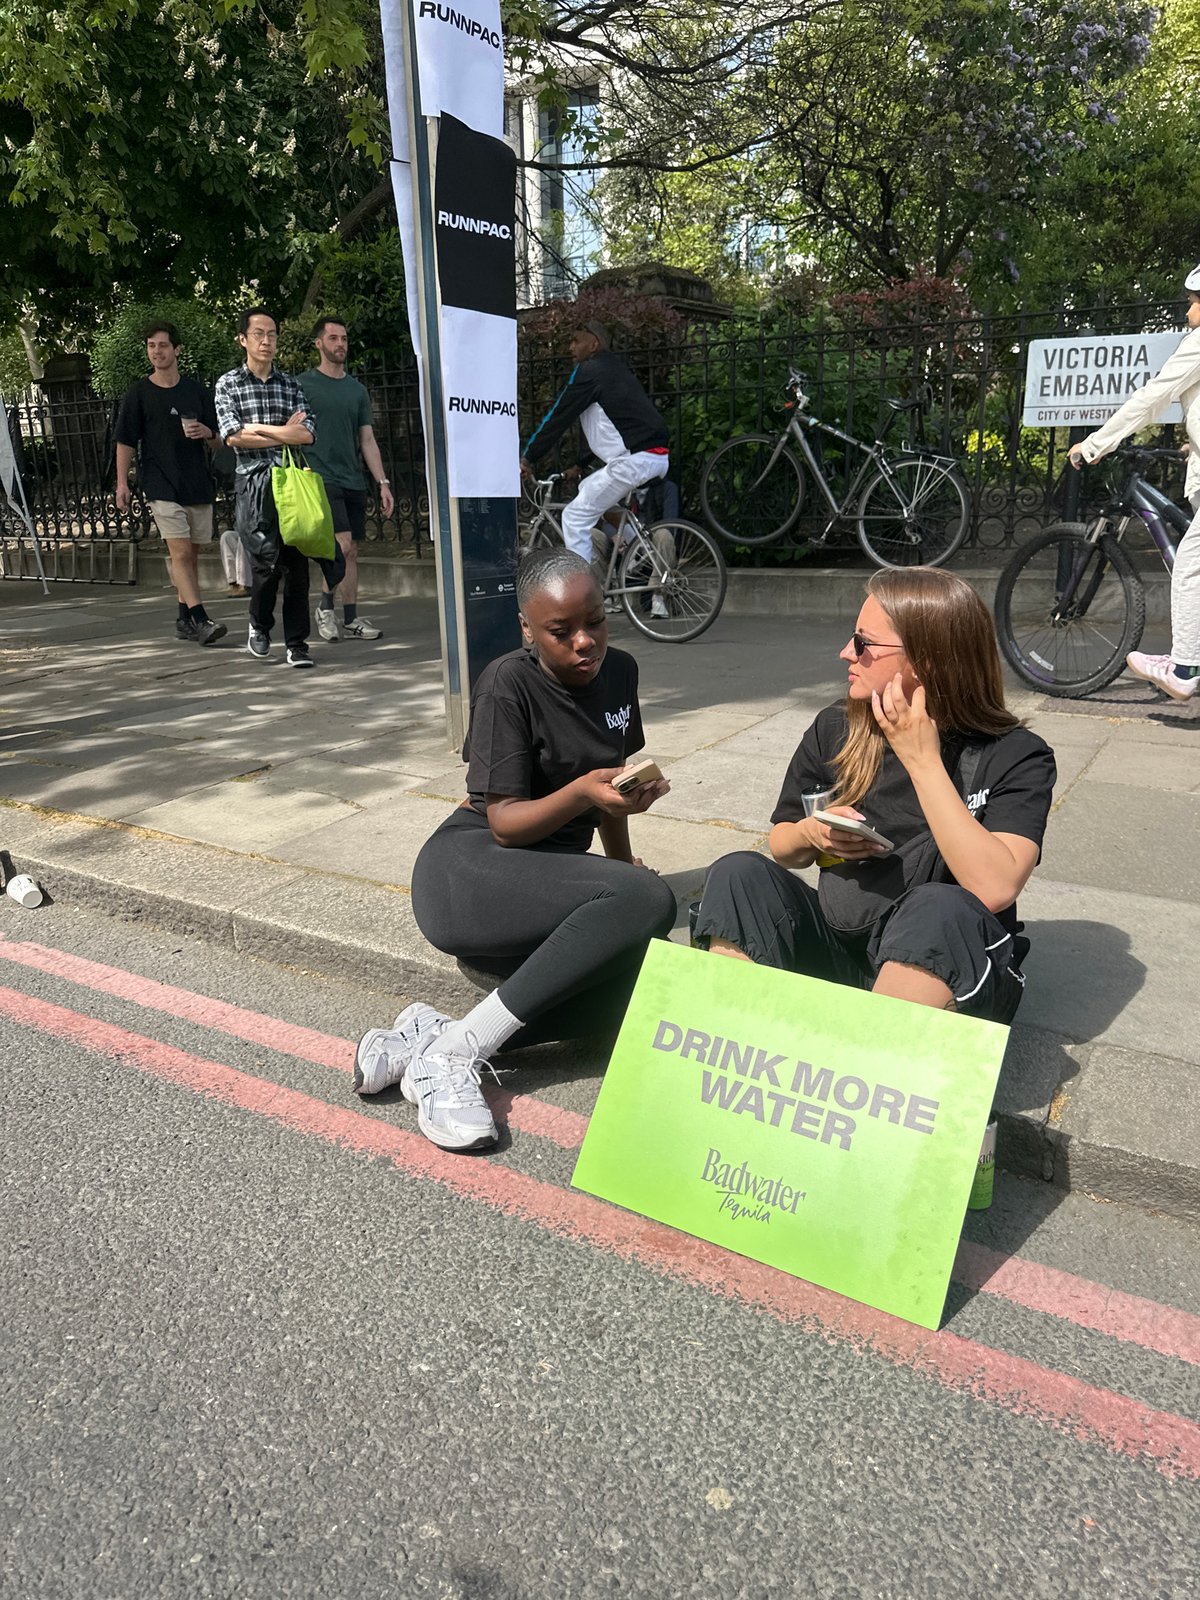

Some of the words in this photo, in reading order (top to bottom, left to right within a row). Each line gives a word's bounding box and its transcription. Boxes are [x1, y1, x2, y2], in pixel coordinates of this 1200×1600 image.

[1044, 345, 1148, 370] VICTORIA
[449, 397, 516, 417] RUNNPAC
[1038, 411, 1060, 421] CITY
[1064, 410, 1076, 420] OF
[651, 1020, 789, 1088] DRINK
[791, 1061, 939, 1135] MORE
[701, 1070, 858, 1151] WATER
[701, 1147, 807, 1215] Badwater
[715, 1190, 771, 1225] Tequila
